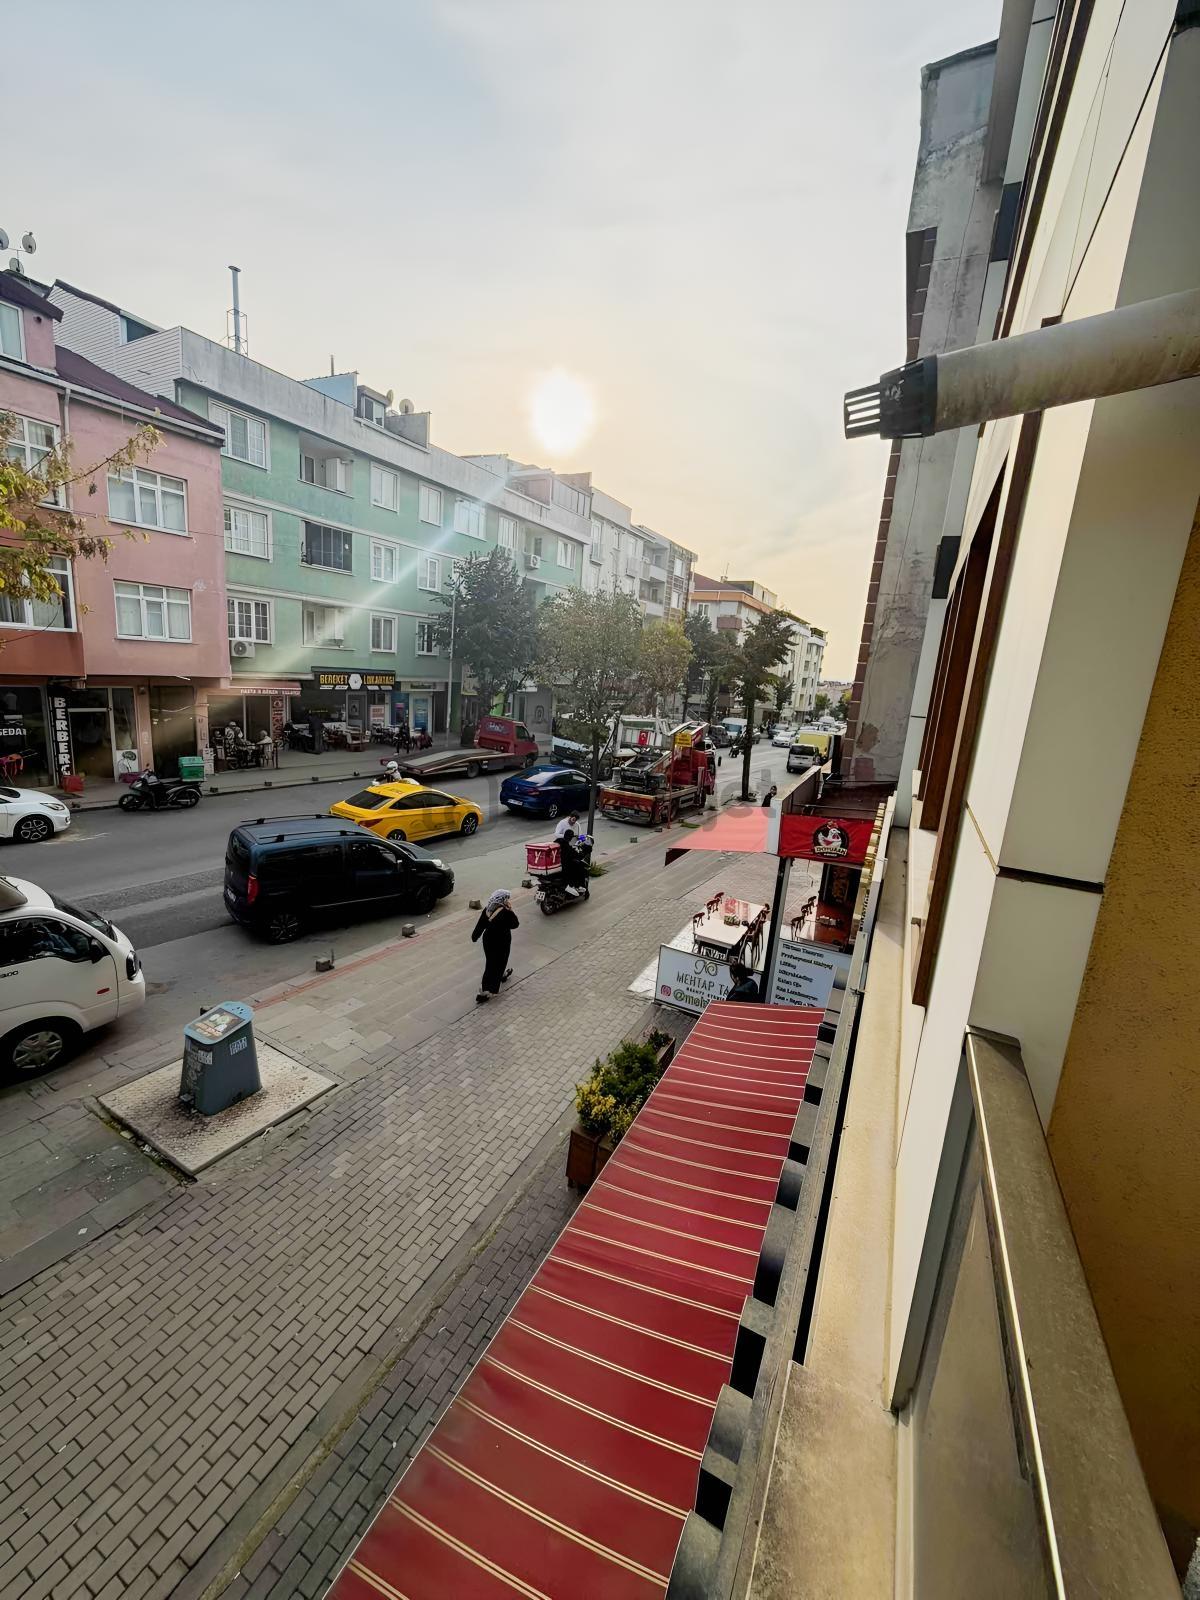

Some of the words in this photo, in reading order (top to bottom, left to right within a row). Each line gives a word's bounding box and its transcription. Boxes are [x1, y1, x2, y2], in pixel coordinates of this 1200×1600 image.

[320, 674, 348, 684] BEREKET
[54, 697, 71, 764] BERBER
[676, 971, 715, 991] MEHTAP
[719, 983, 730, 997] TA
